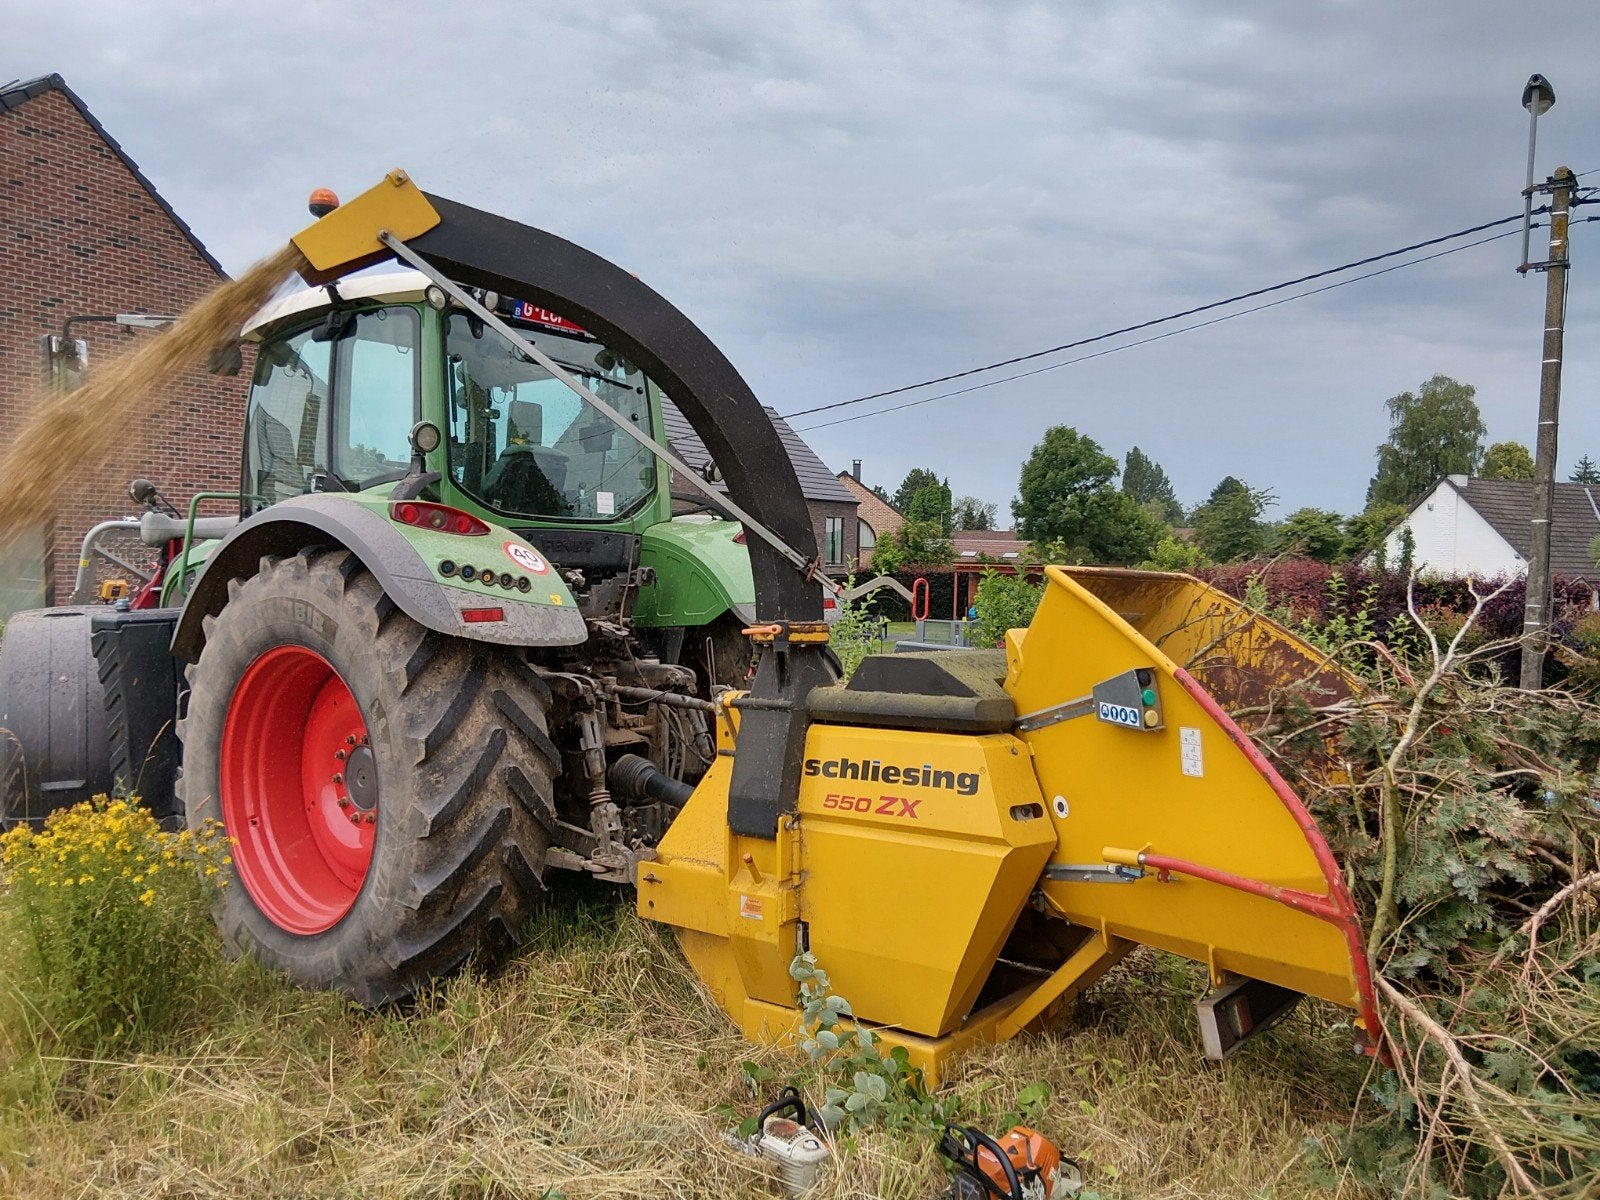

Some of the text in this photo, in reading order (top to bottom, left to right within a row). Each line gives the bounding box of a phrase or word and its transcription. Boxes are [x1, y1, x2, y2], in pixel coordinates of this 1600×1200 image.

[514, 307, 521, 316] B
[513, 548, 539, 564] 40
[804, 758, 980, 796] schliesing
[823, 793, 923, 819] 550 ZX
